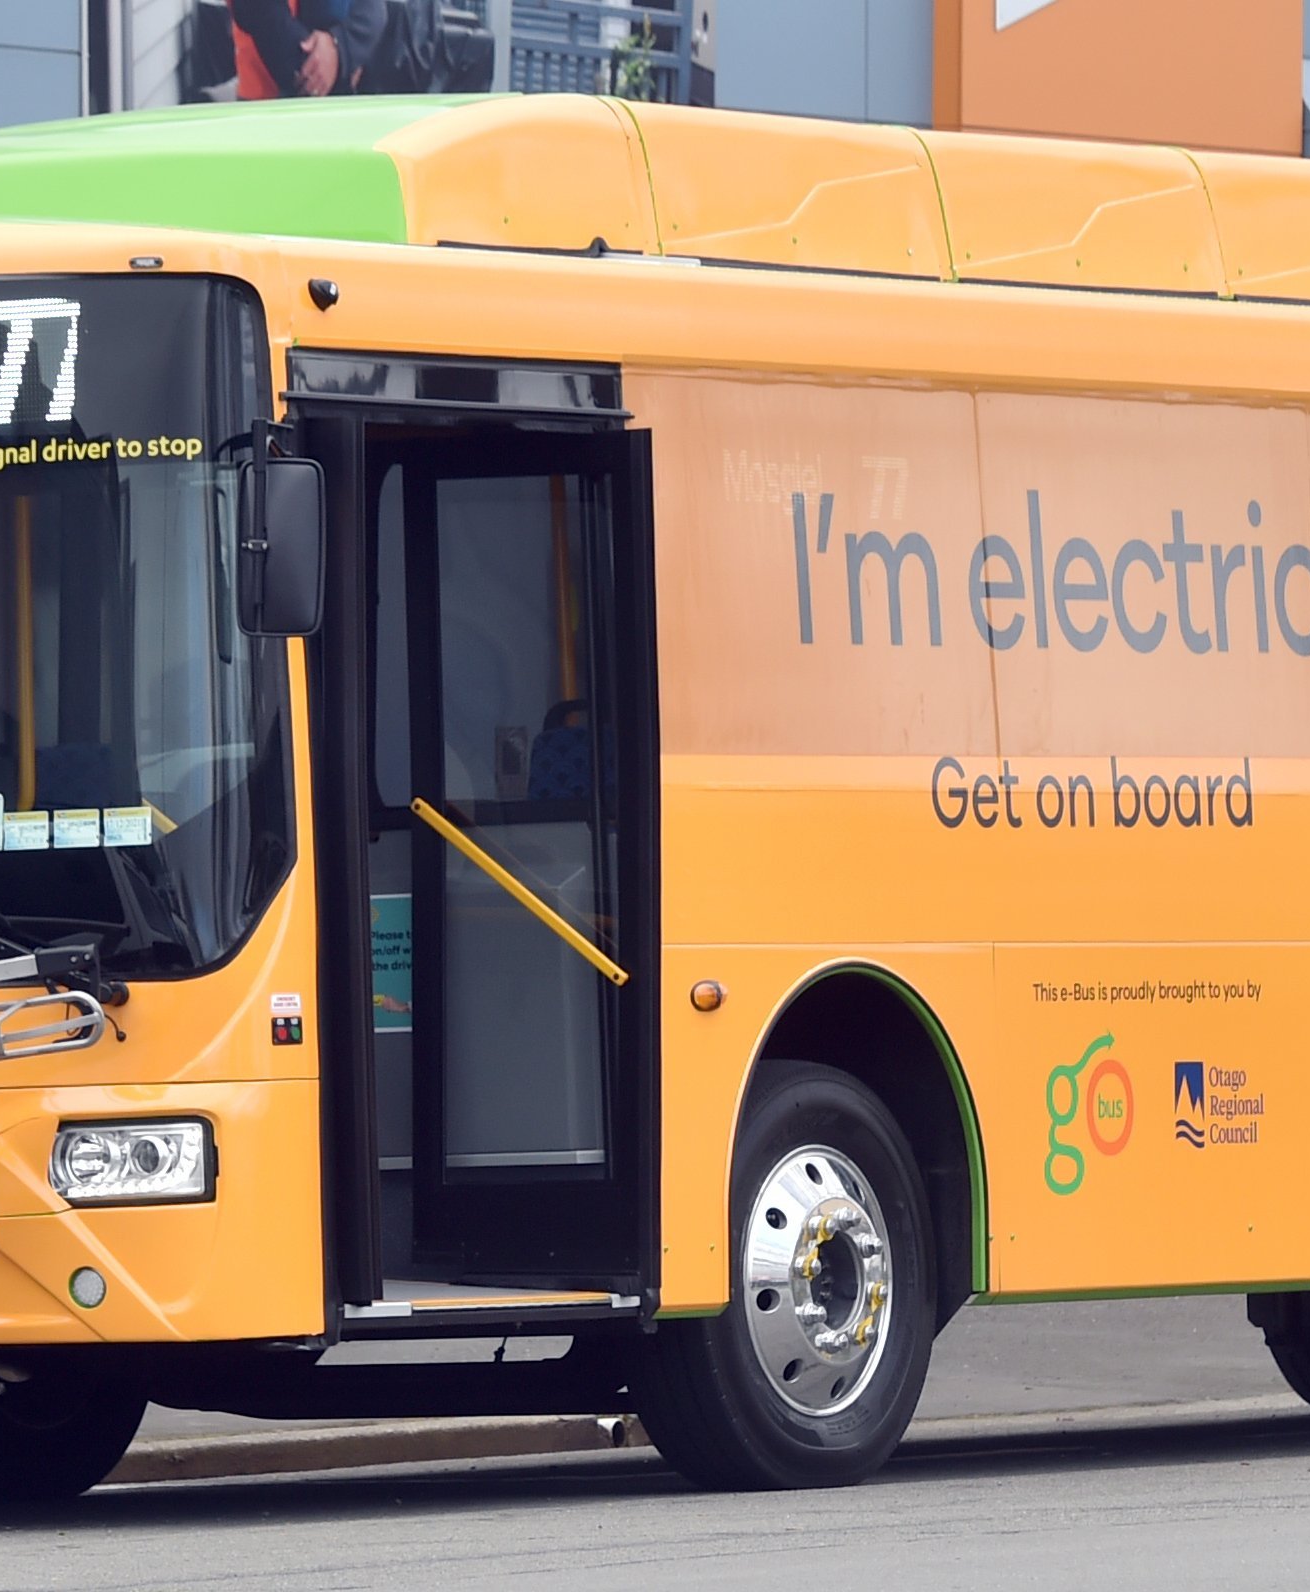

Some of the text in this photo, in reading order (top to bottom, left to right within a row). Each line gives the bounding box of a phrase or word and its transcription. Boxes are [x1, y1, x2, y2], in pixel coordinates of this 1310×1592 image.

[41, 438, 111, 462] driver
[116, 437, 142, 458] to
[147, 436, 203, 460] stop
[792, 490, 942, 648] I'm
[931, 755, 1253, 828] Get on board
[1033, 979, 1262, 1004] This e-Bus is proudly brought to you by
[1209, 1066, 1247, 1091] Otago
[1097, 1093, 1123, 1119] bus
[1210, 1094, 1265, 1121] Regional
[1210, 1122, 1258, 1144] Council
